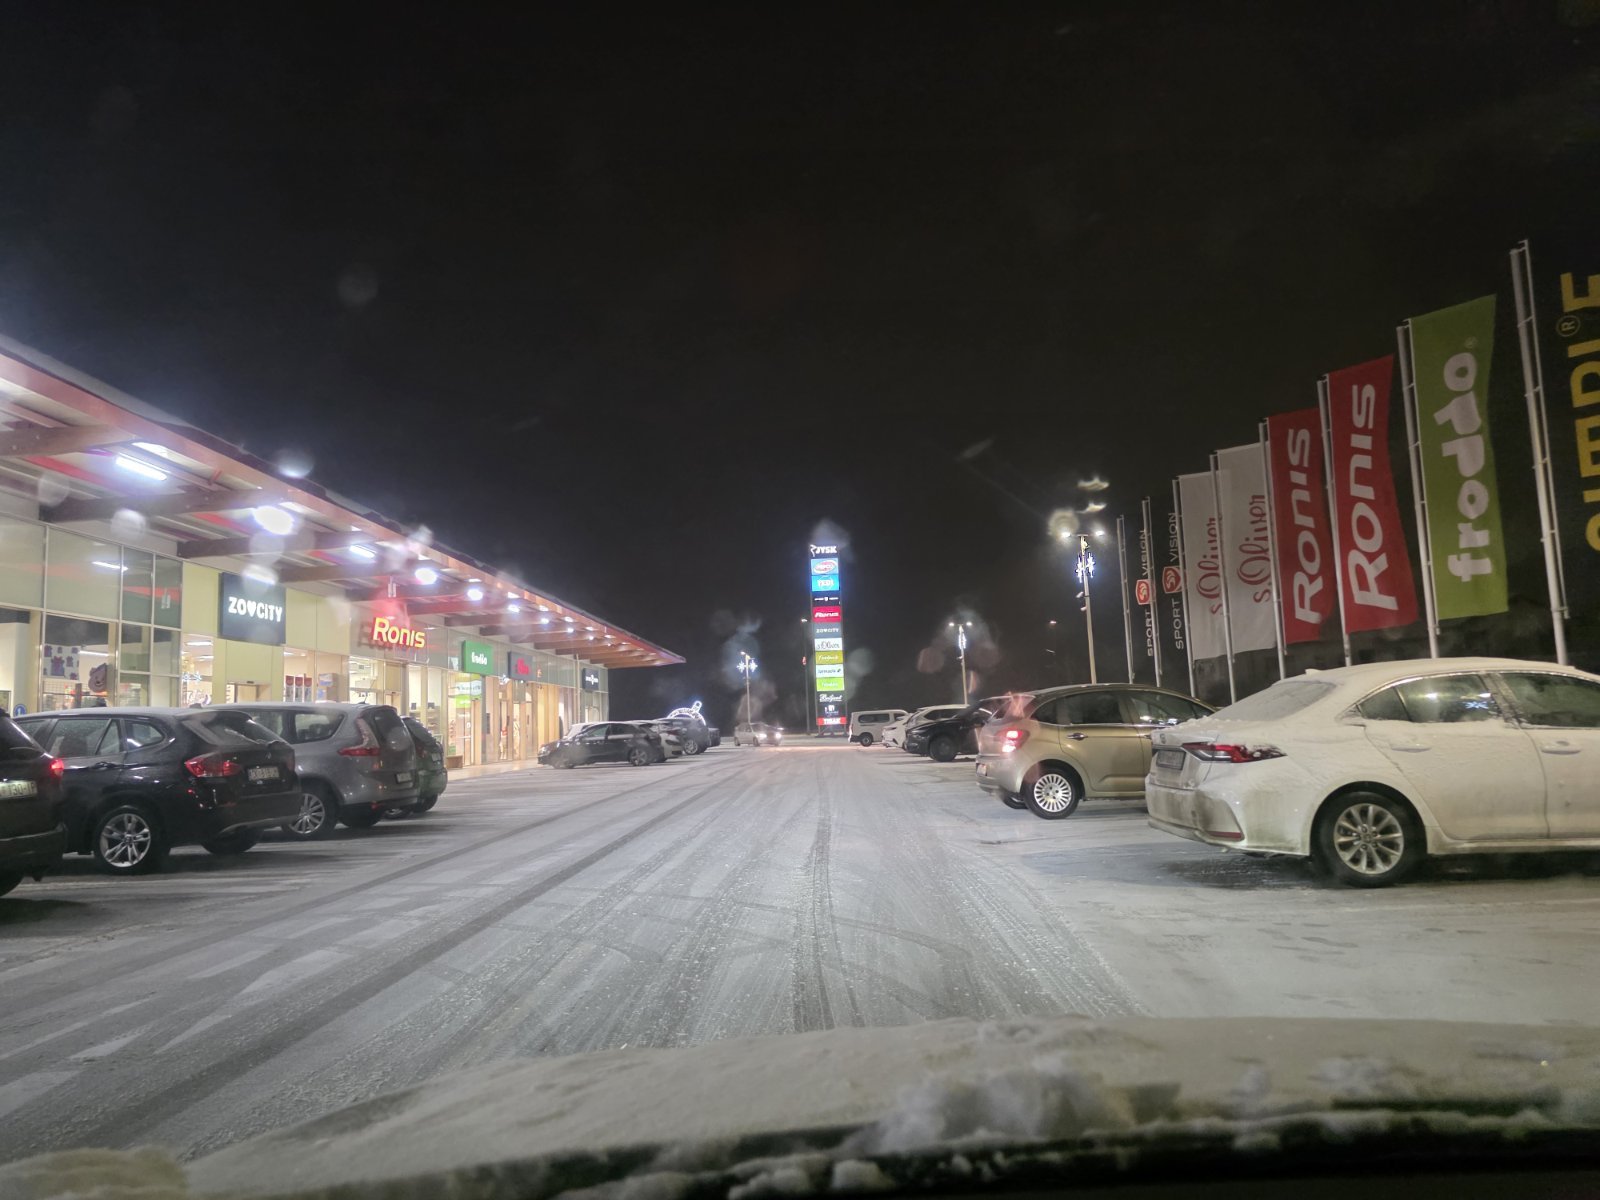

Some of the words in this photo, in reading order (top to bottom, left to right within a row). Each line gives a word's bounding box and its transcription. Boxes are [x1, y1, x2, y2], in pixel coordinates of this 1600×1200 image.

[1433, 352, 1493, 582] froddo
[1167, 512, 1181, 563] VISION
[1146, 611, 1155, 657] SPORT
[1171, 598, 1185, 650] SPORT
